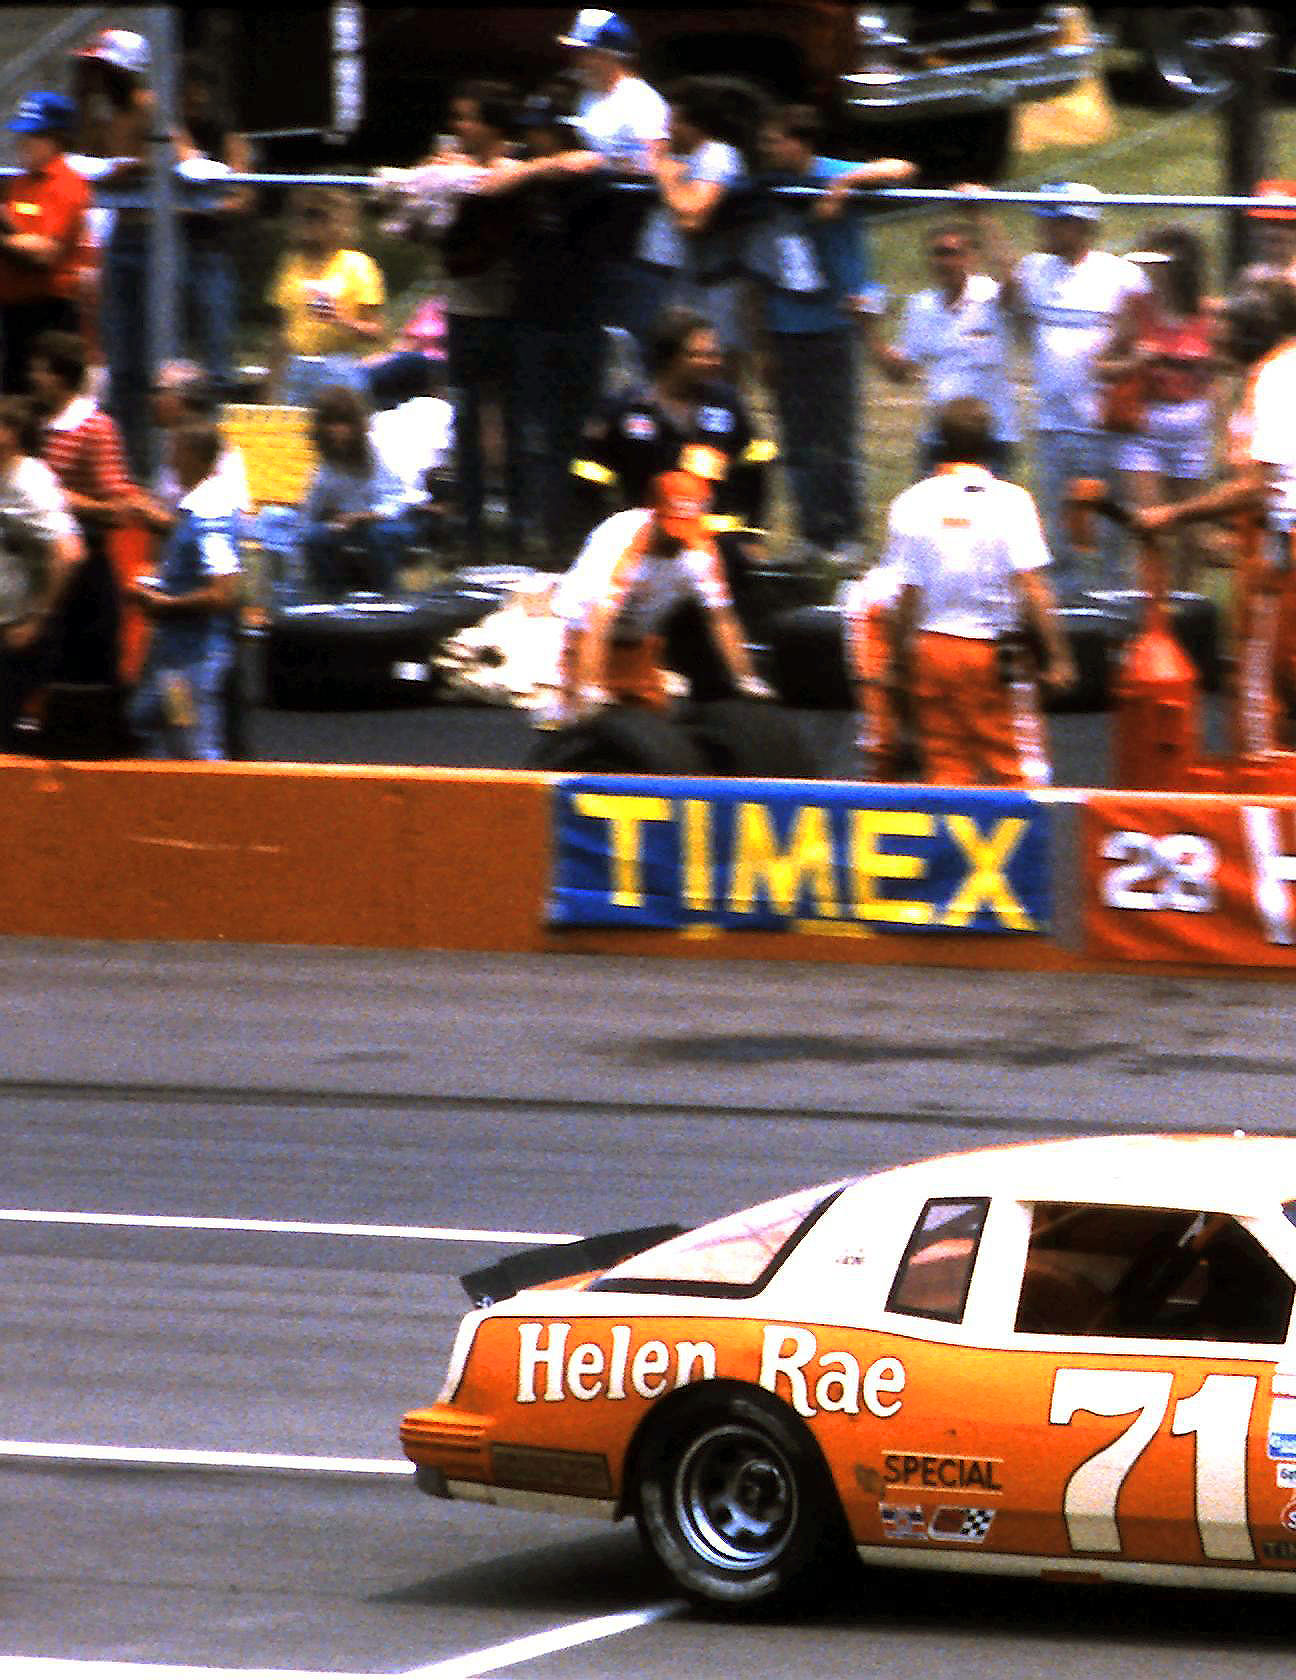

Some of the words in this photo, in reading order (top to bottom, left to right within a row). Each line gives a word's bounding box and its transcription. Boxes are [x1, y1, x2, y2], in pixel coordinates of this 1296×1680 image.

[574, 792, 1037, 932] TIMEX
[516, 1322, 718, 1404] Helen
[758, 1325, 907, 1417] Rae
[882, 1455, 1003, 1489] SPECIAL
[1048, 1367, 1258, 1561] 71
